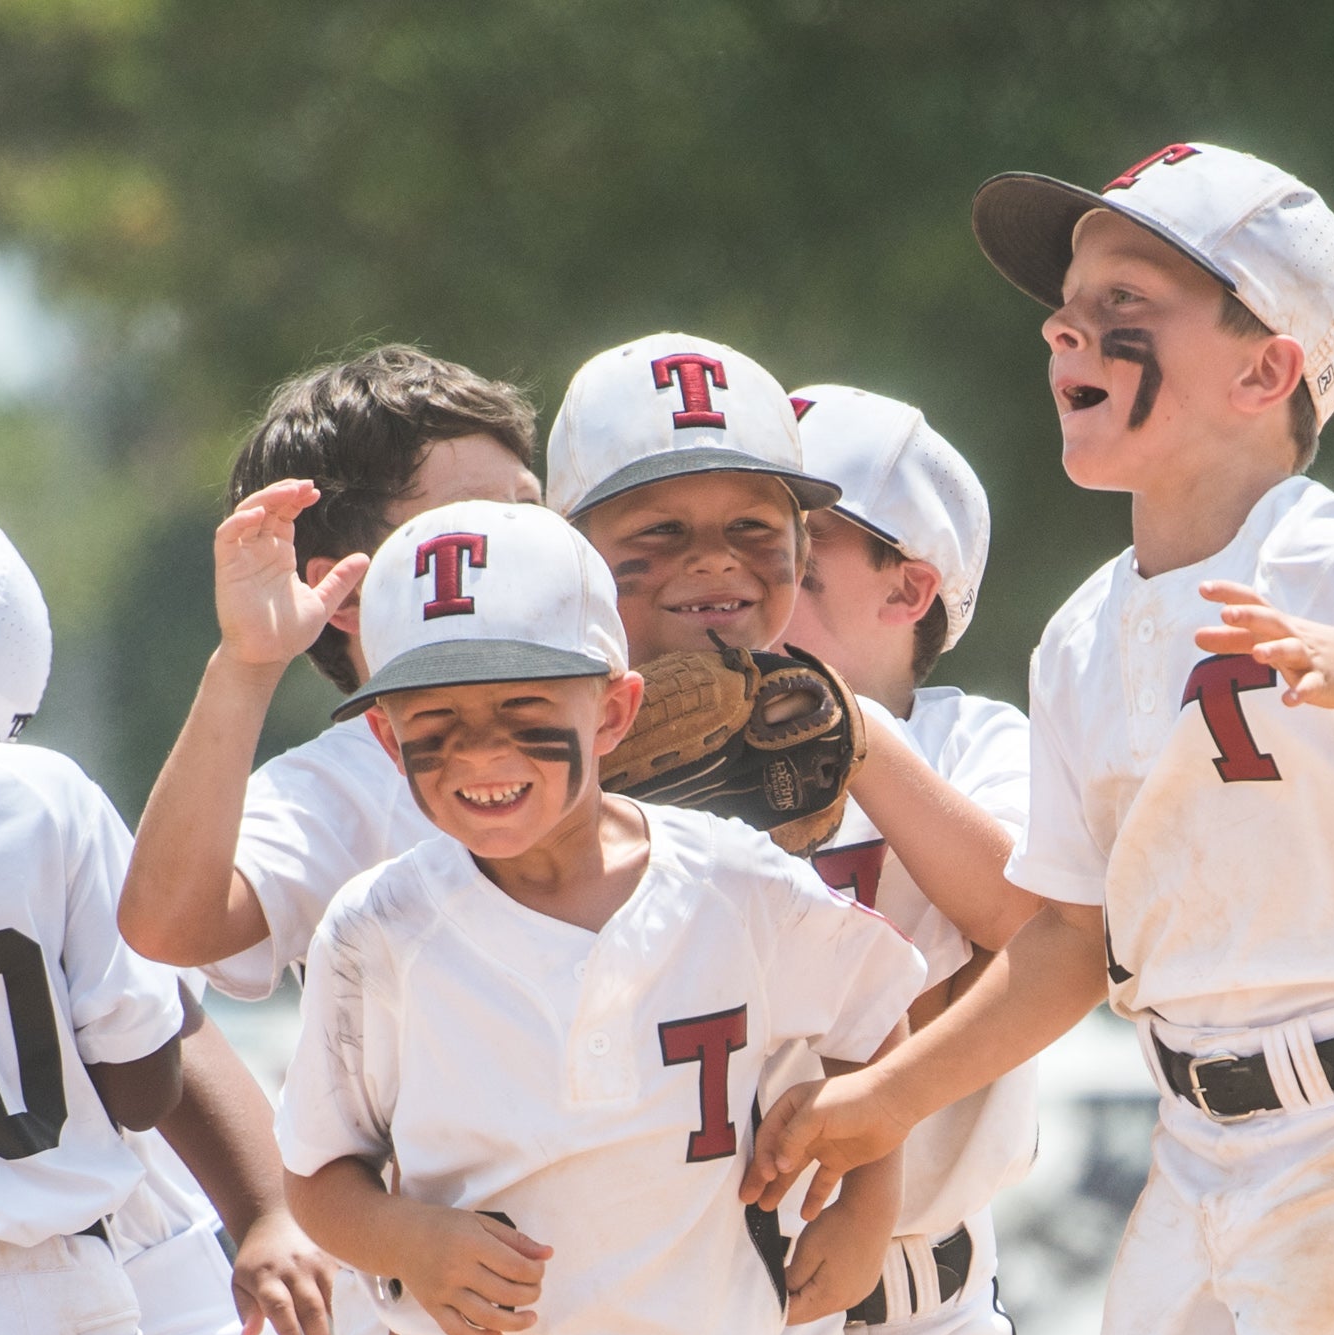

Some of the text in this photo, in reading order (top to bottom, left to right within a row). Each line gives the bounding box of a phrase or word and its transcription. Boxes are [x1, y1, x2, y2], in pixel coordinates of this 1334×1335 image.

[651, 352, 729, 430] T
[414, 531, 488, 621] T
[1180, 653, 1283, 783] T
[657, 1002, 748, 1163] T
